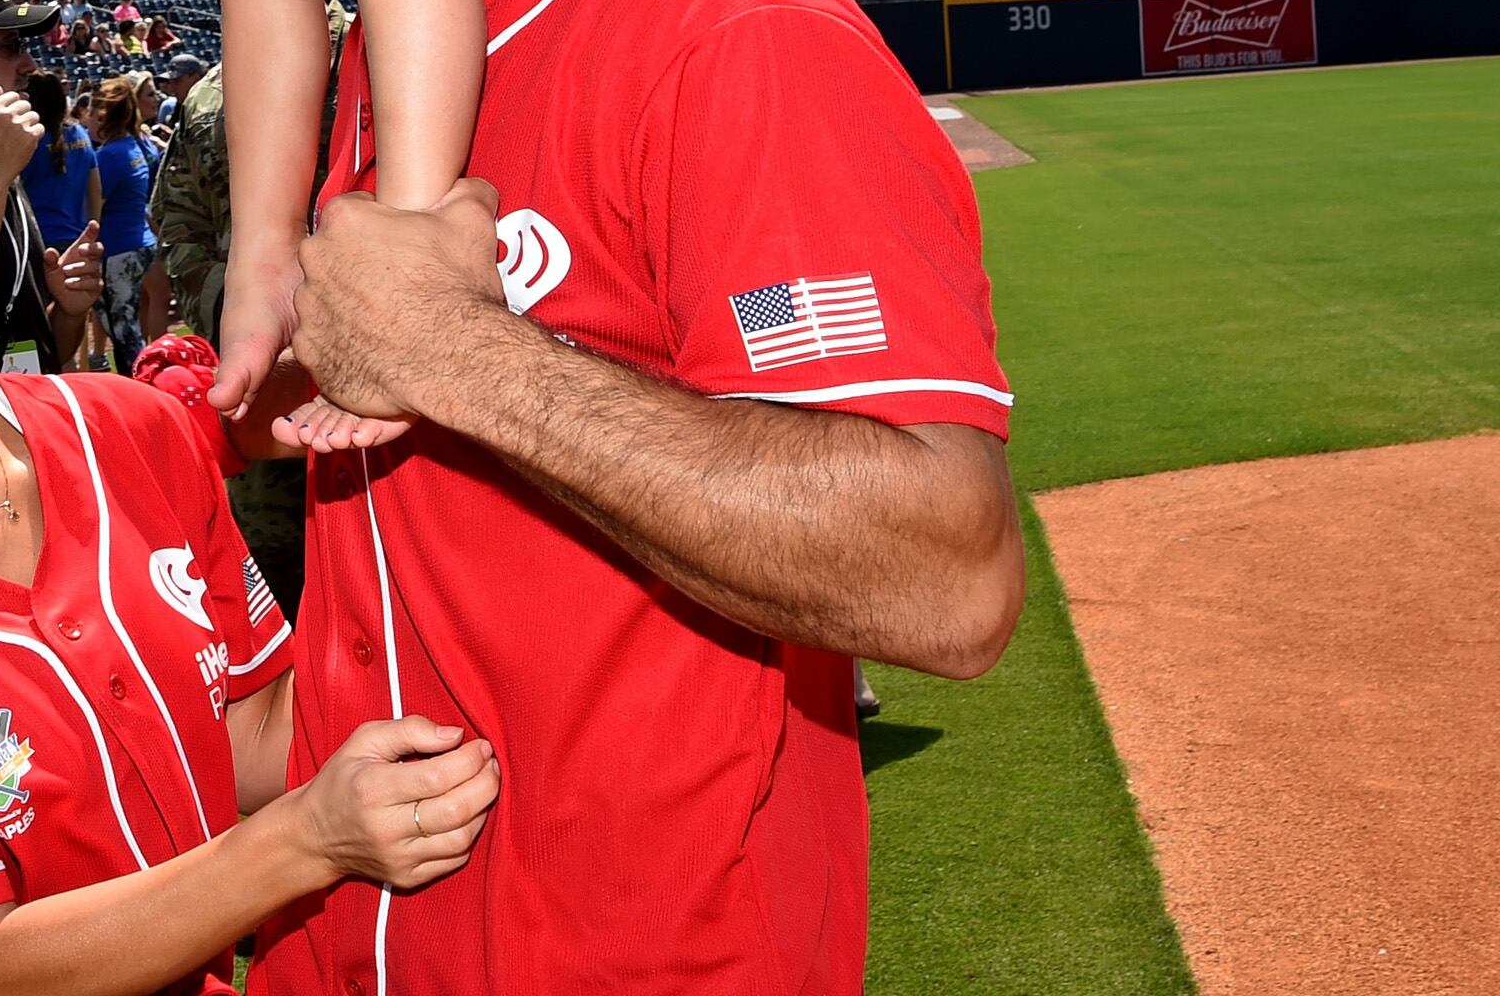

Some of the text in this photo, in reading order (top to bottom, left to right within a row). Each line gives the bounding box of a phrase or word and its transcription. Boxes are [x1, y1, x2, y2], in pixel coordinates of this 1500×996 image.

[1009, 5, 1050, 31] 330
[1174, 9, 1280, 36] Budweiser
[1178, 55, 1200, 69] THIS
[1204, 52, 1236, 67] BUD'S
[1237, 51, 1259, 65] FOR
